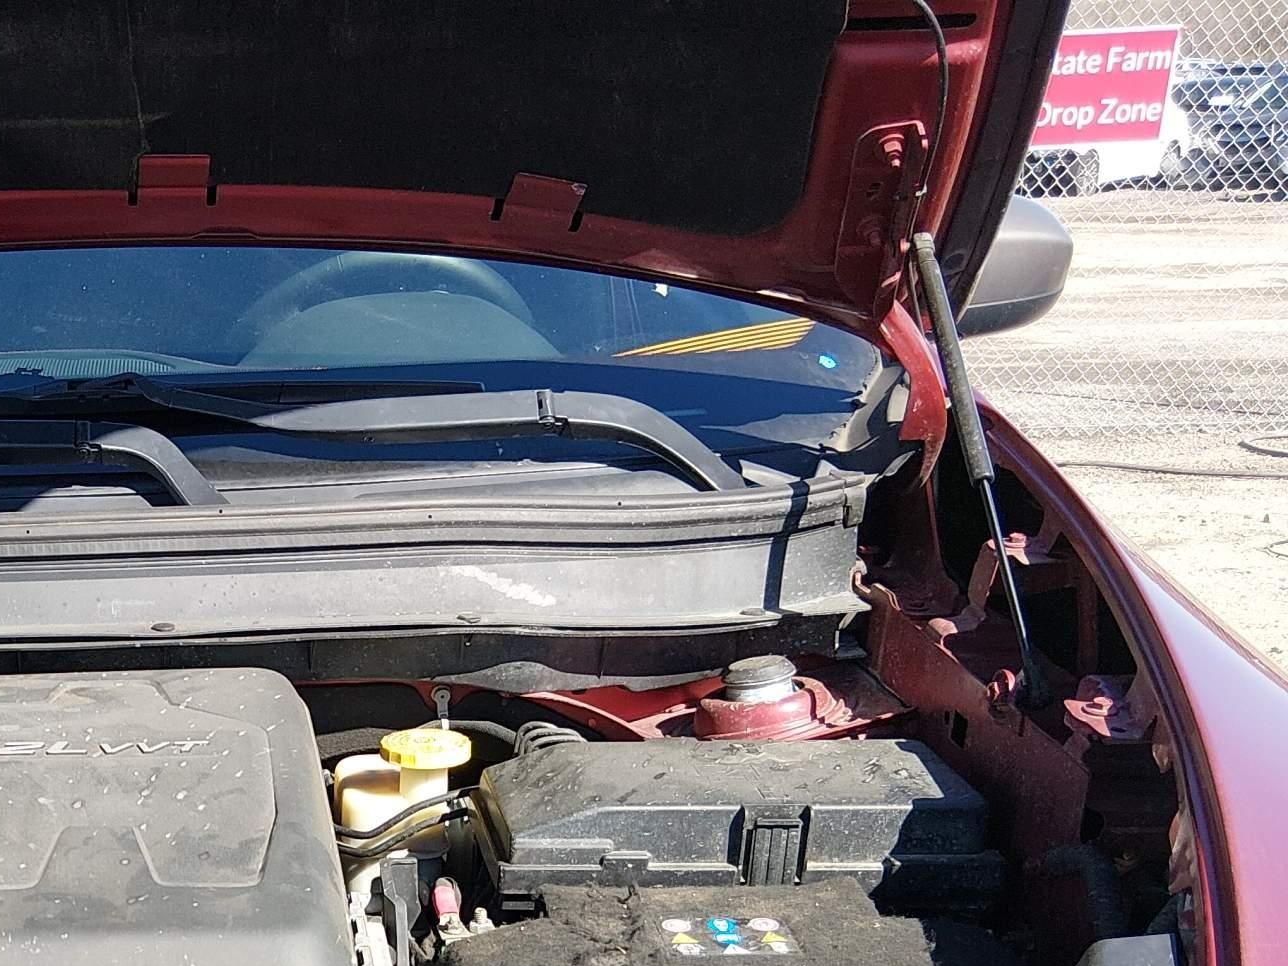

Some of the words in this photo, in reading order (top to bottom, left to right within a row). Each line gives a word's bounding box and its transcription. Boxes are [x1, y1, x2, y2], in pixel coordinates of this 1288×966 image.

[1051, 49, 1102, 75] tate
[1105, 45, 1172, 73] Farm
[1099, 98, 1160, 125] Zone
[99, 739, 210, 755] VVT
